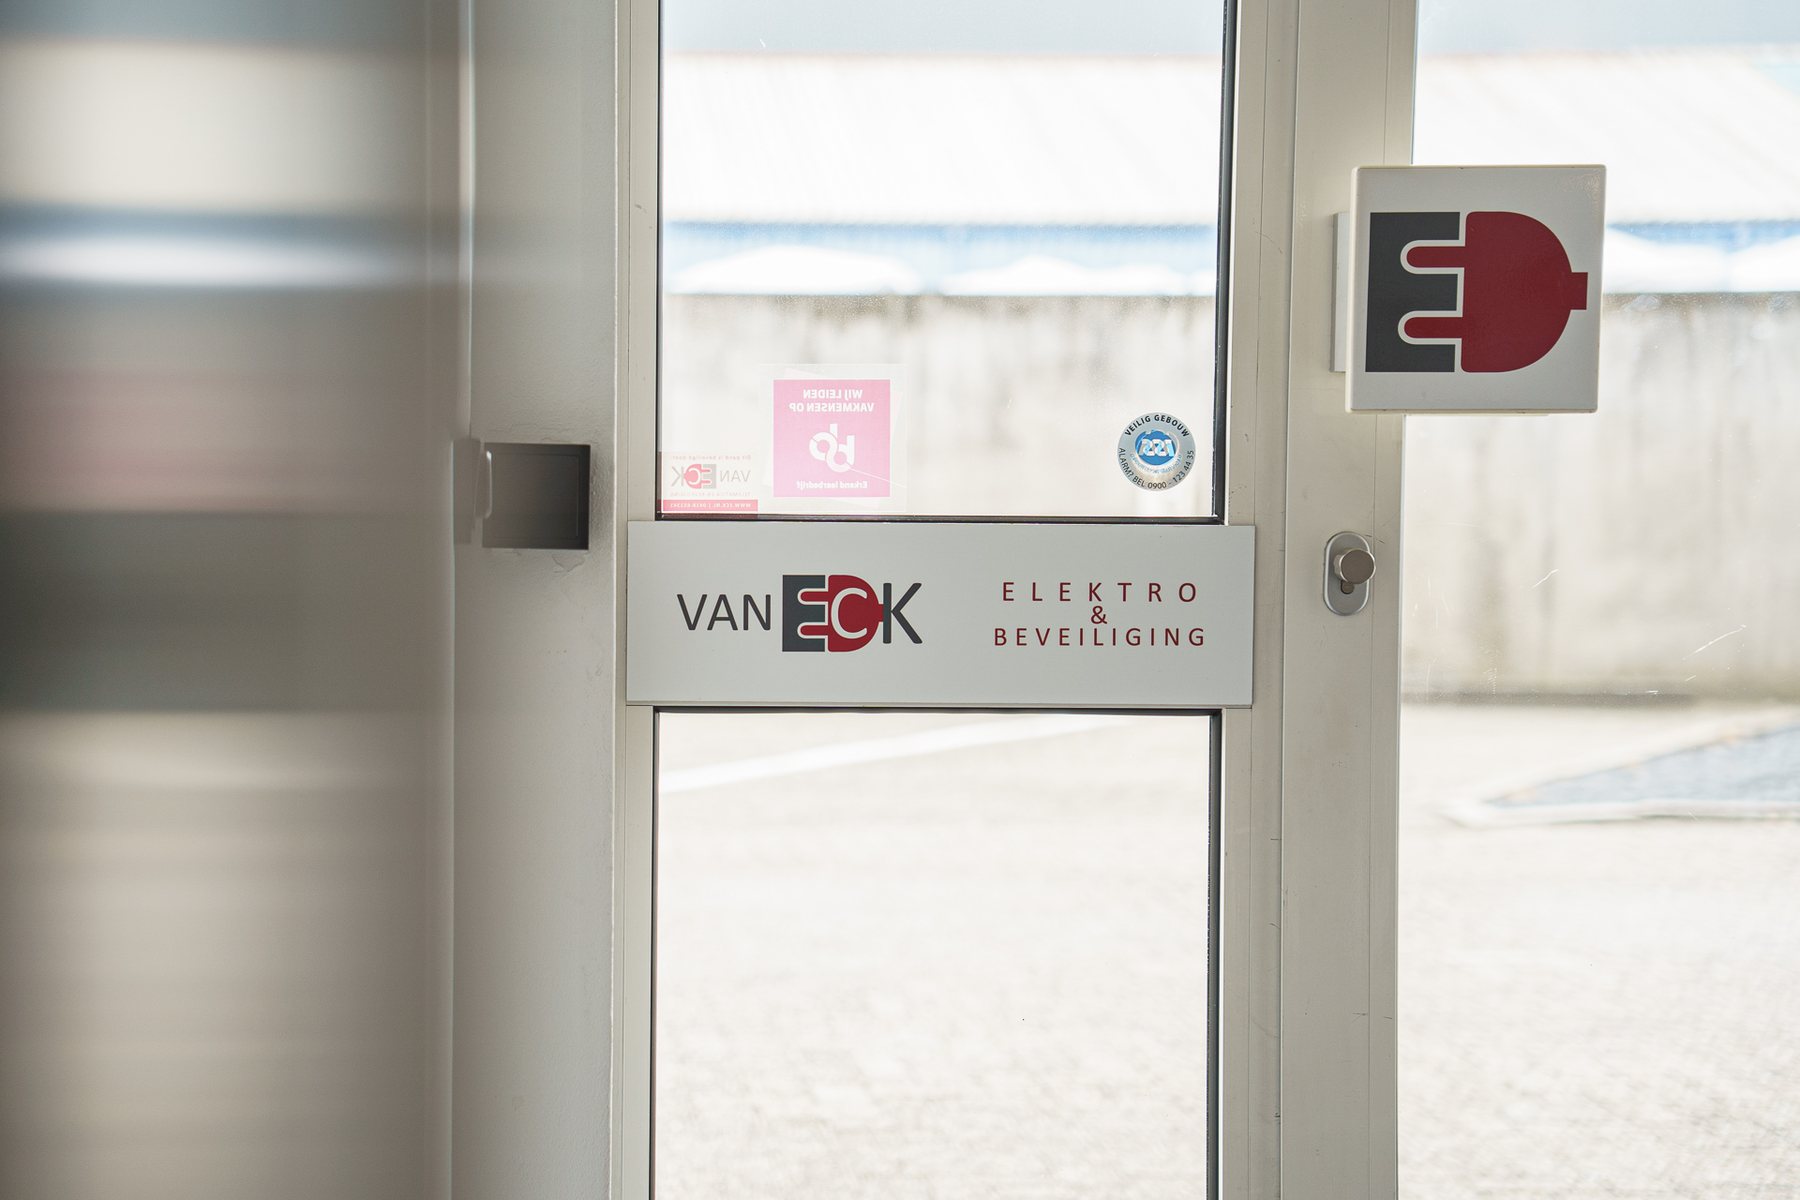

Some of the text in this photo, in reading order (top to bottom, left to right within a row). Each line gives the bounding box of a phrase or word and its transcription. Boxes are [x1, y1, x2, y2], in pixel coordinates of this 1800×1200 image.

[1125, 414, 1190, 437] VEILIG GEBOUW
[1119, 447, 1134, 477] ALARM?
[1187, 450, 1194, 460] 35
[1184, 461, 1191, 471] 44
[1133, 475, 1145, 487] BEL
[1147, 481, 1167, 489] 0900
[1173, 471, 1186, 482] 123
[1002, 582, 1198, 603] ELEKTRO
[677, 574, 923, 652] VAN ECK
[1091, 605, 1108, 625] &
[994, 627, 1206, 647] BEVEILIGING
